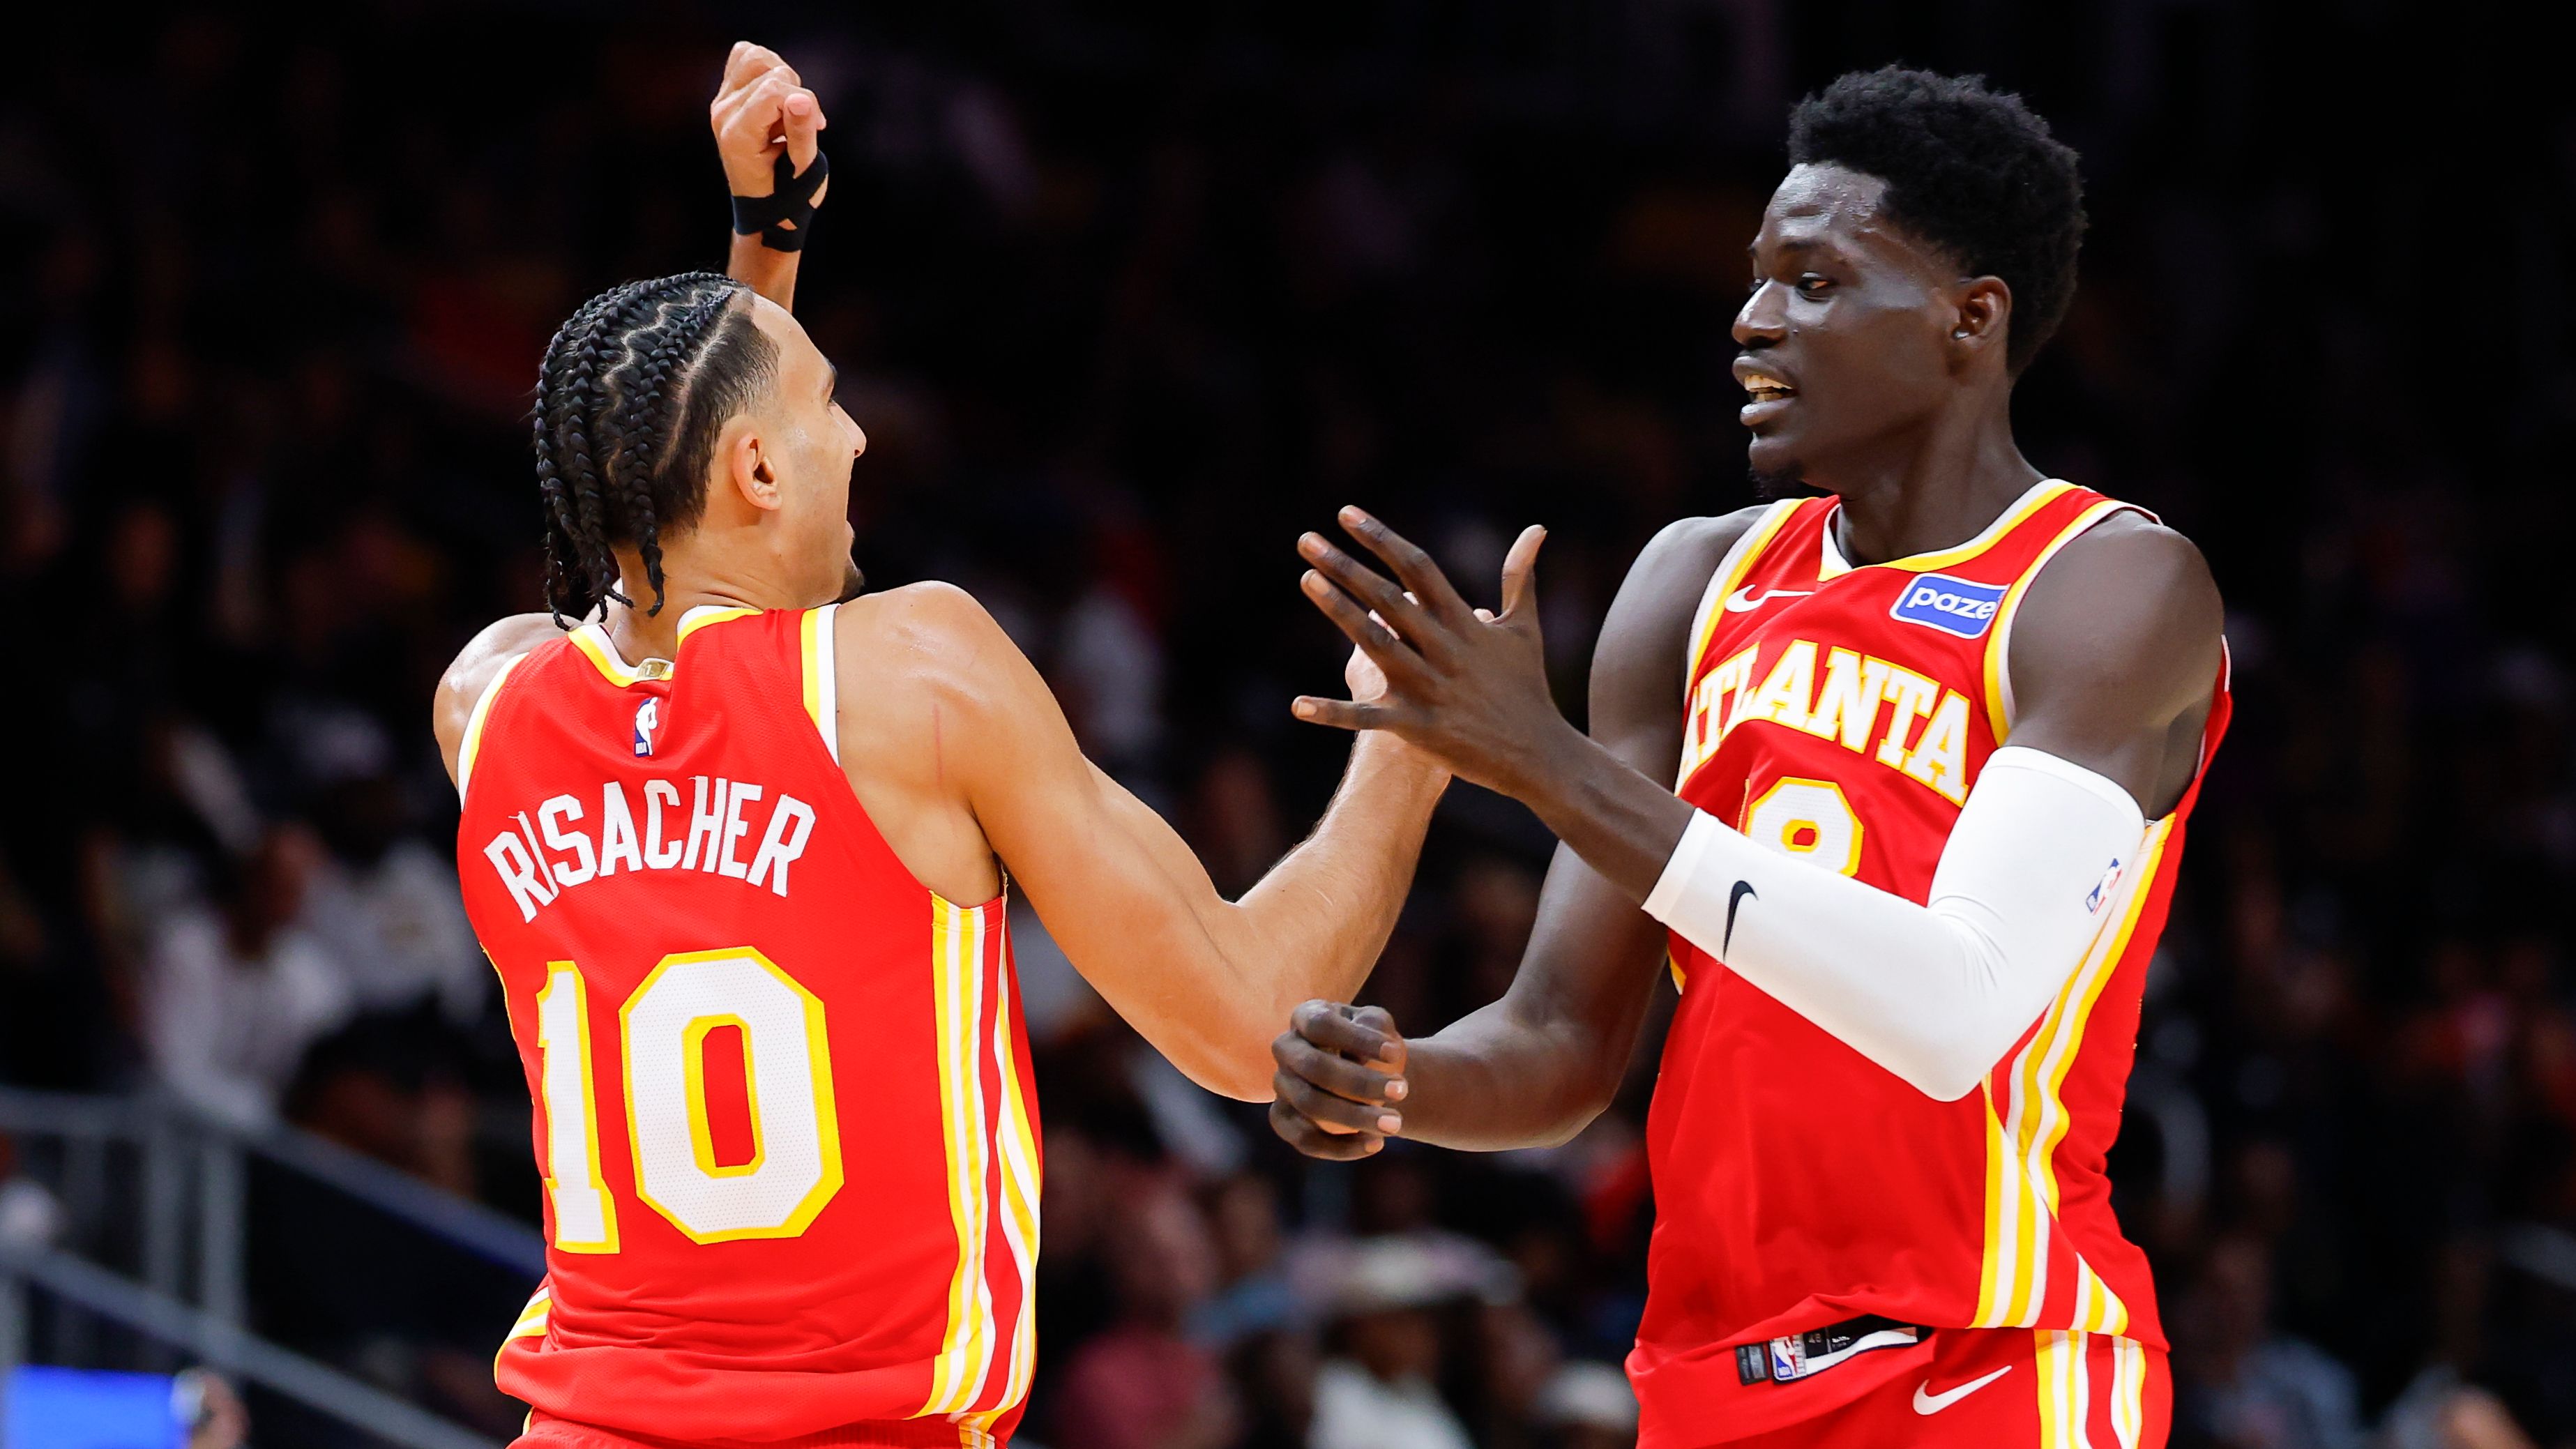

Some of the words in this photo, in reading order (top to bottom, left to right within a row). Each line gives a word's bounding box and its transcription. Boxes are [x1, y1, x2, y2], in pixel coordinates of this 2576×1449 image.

[1906, 587, 1999, 619] paze
[1674, 639, 1970, 807] ATLANTA
[483, 775, 816, 923] RISACHER
[536, 946, 844, 1254] 10
